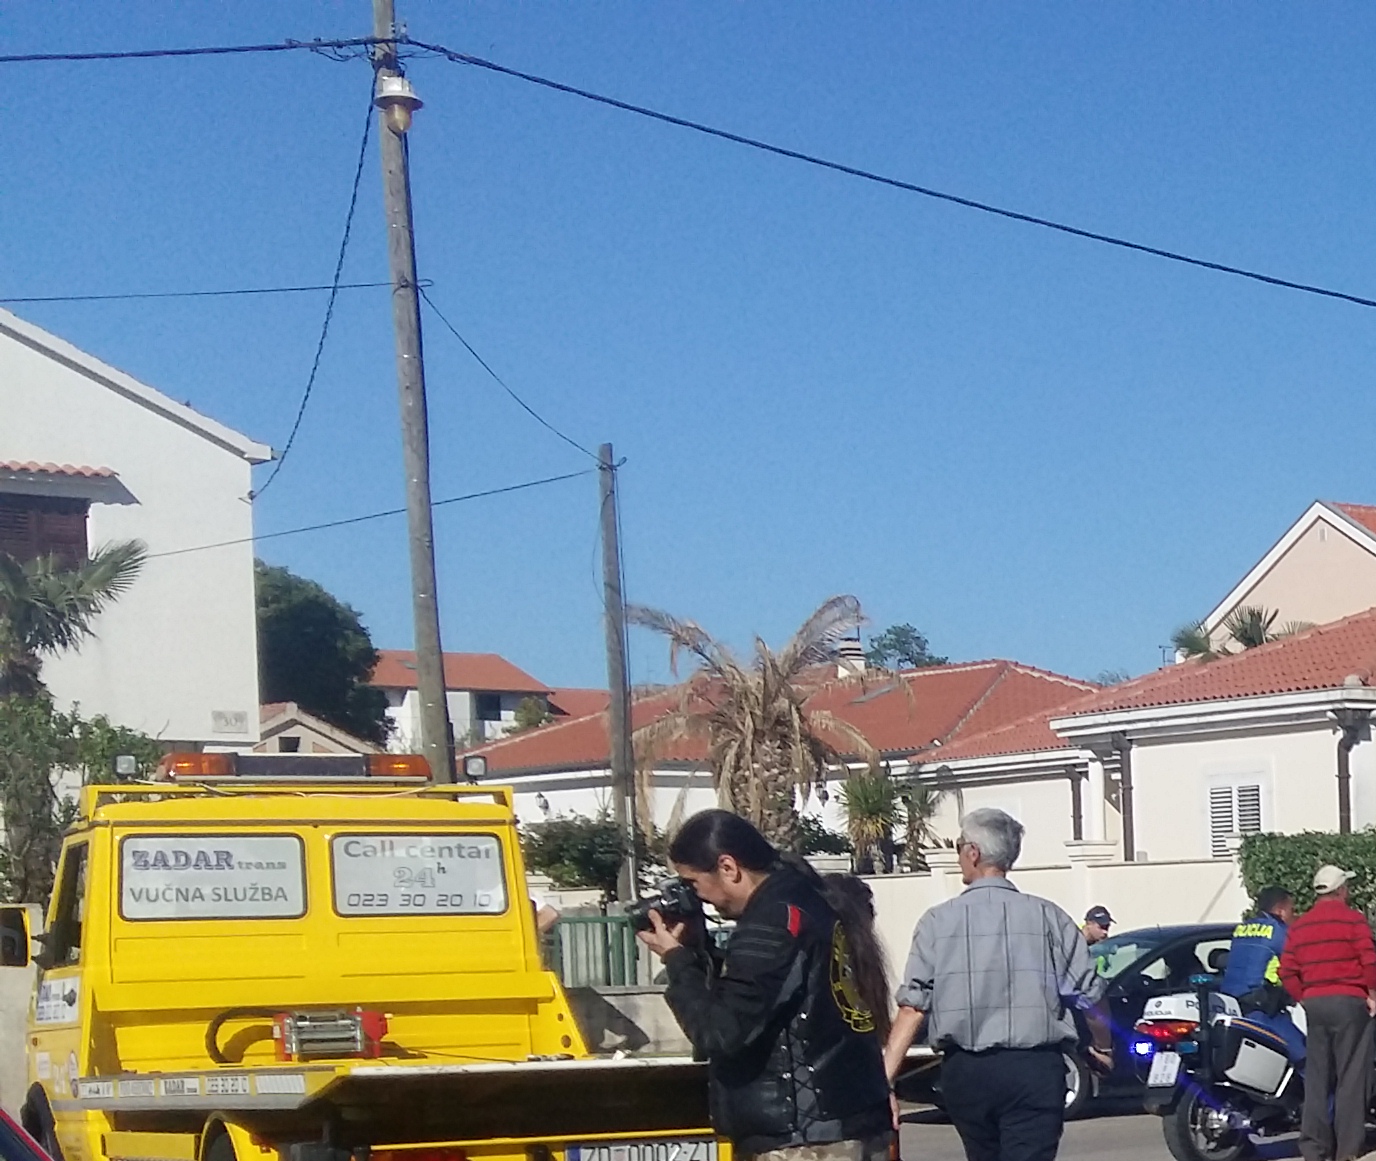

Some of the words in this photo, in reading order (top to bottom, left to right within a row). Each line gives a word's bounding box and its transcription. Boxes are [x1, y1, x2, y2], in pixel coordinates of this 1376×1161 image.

[343, 839, 395, 858] Call
[131, 849, 235, 871] ZADAR
[237, 860, 288, 871] trans
[129, 883, 206, 903] VUČNA
[211, 882, 289, 902] SLUŽBA
[347, 893, 389, 907] 023
[398, 893, 426, 907] 30
[436, 893, 464, 907] 20
[1233, 923, 1274, 940] OLICIJA
